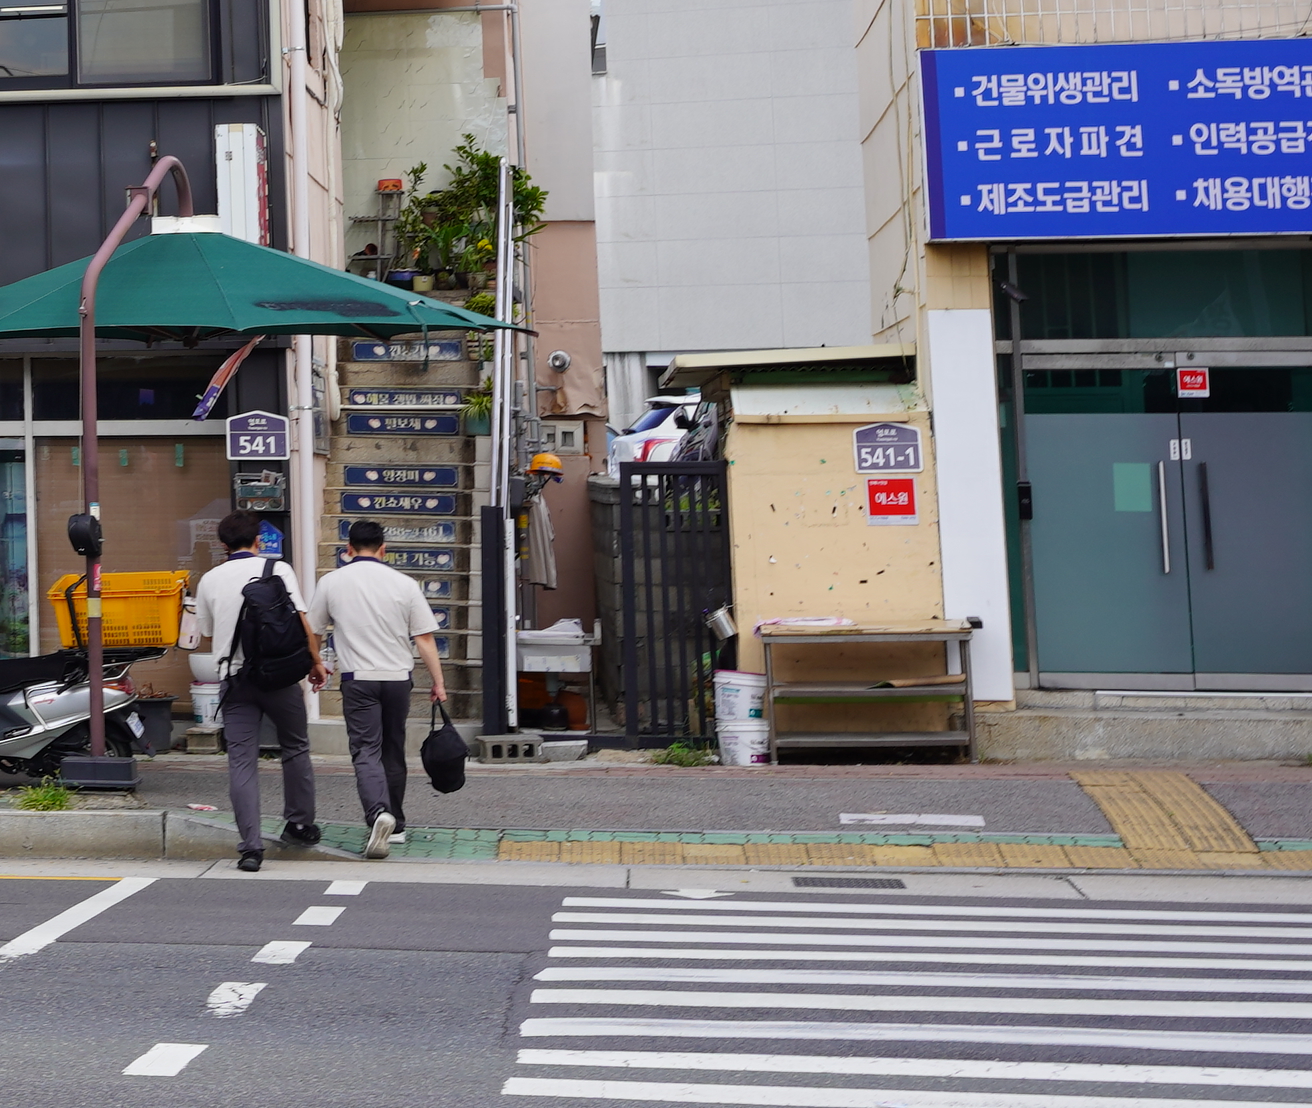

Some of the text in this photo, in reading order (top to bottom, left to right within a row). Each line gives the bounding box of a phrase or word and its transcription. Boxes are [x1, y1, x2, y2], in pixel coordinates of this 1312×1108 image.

[971, 70, 1140, 108] 건물위생관리
[1189, 120, 1312, 155] 인력공급
[977, 179, 1150, 216] 제조도급관리
[239, 435, 276, 454] 541
[860, 447, 915, 467] 541-1
[875, 492, 909, 505] 에스원
